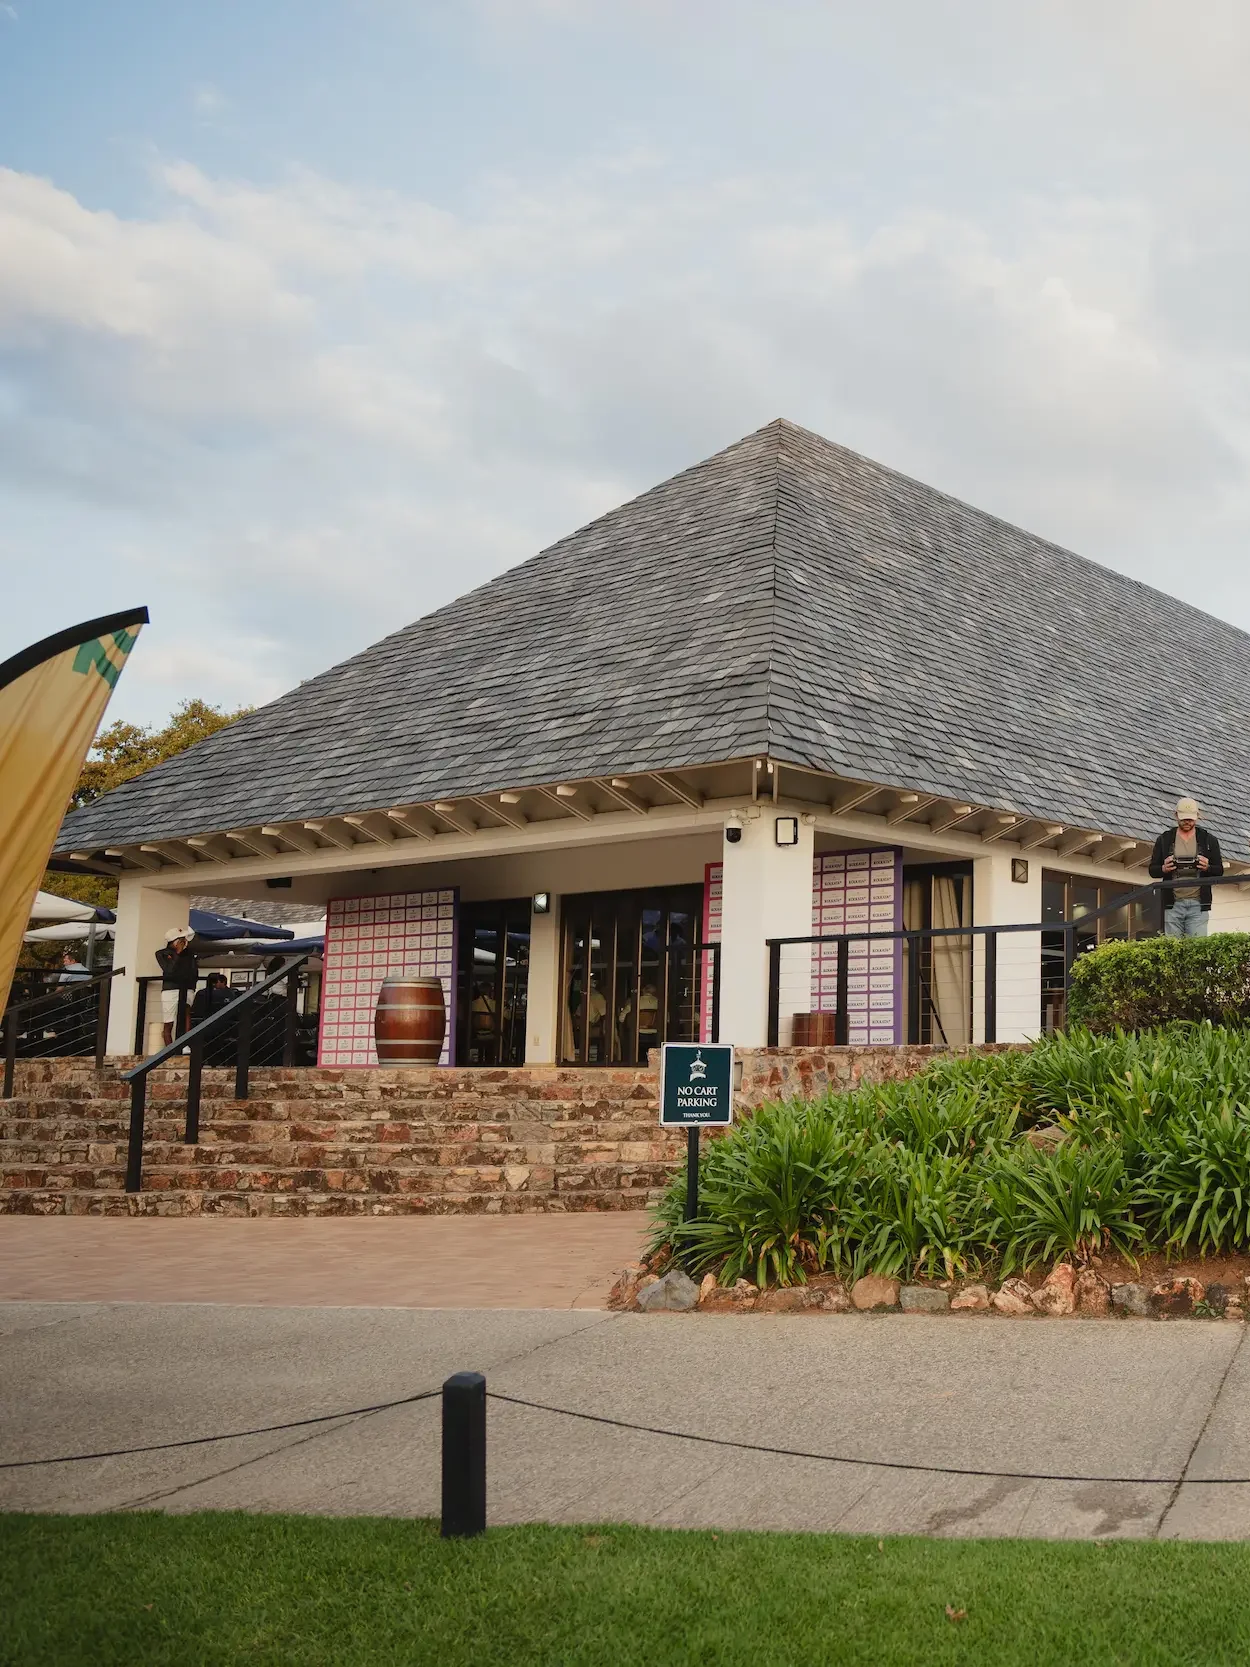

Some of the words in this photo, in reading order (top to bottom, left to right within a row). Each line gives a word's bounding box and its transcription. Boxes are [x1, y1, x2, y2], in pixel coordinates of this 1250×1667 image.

[677, 1086, 692, 1095] NO
[694, 1086, 718, 1095] CART
[677, 1098, 717, 1107] PARKING
